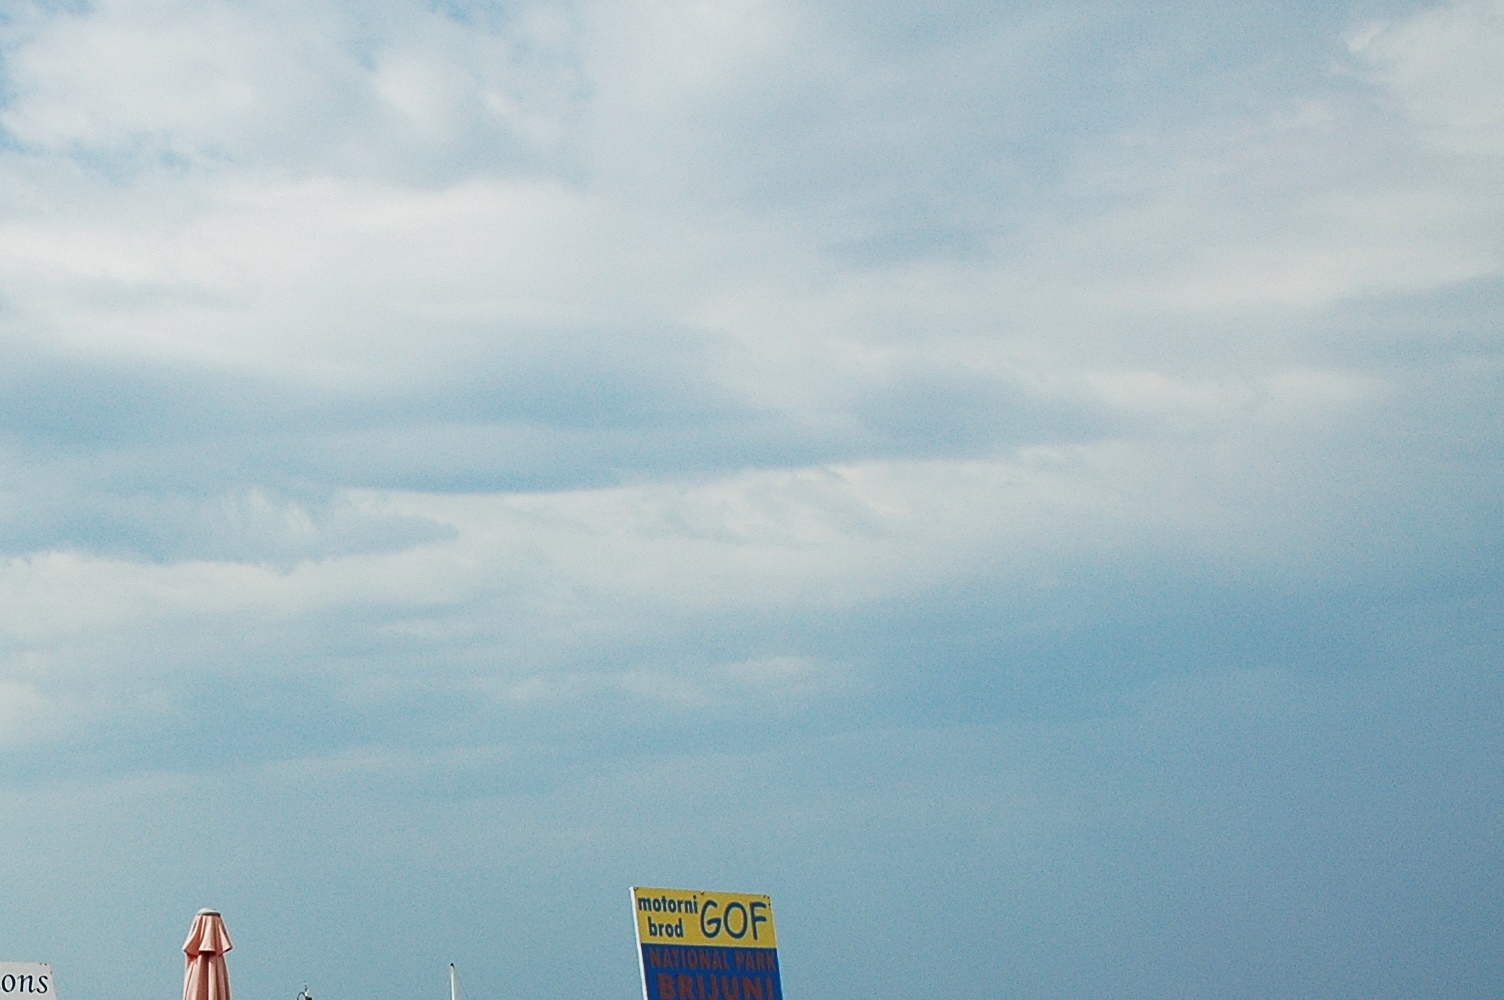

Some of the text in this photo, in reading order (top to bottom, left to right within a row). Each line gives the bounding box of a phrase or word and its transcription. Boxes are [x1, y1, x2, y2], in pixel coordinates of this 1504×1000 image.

[637, 895, 767, 940] motorni GOF
[647, 916, 684, 938] brod
[648, 948, 776, 972] NATIONAL PARK
